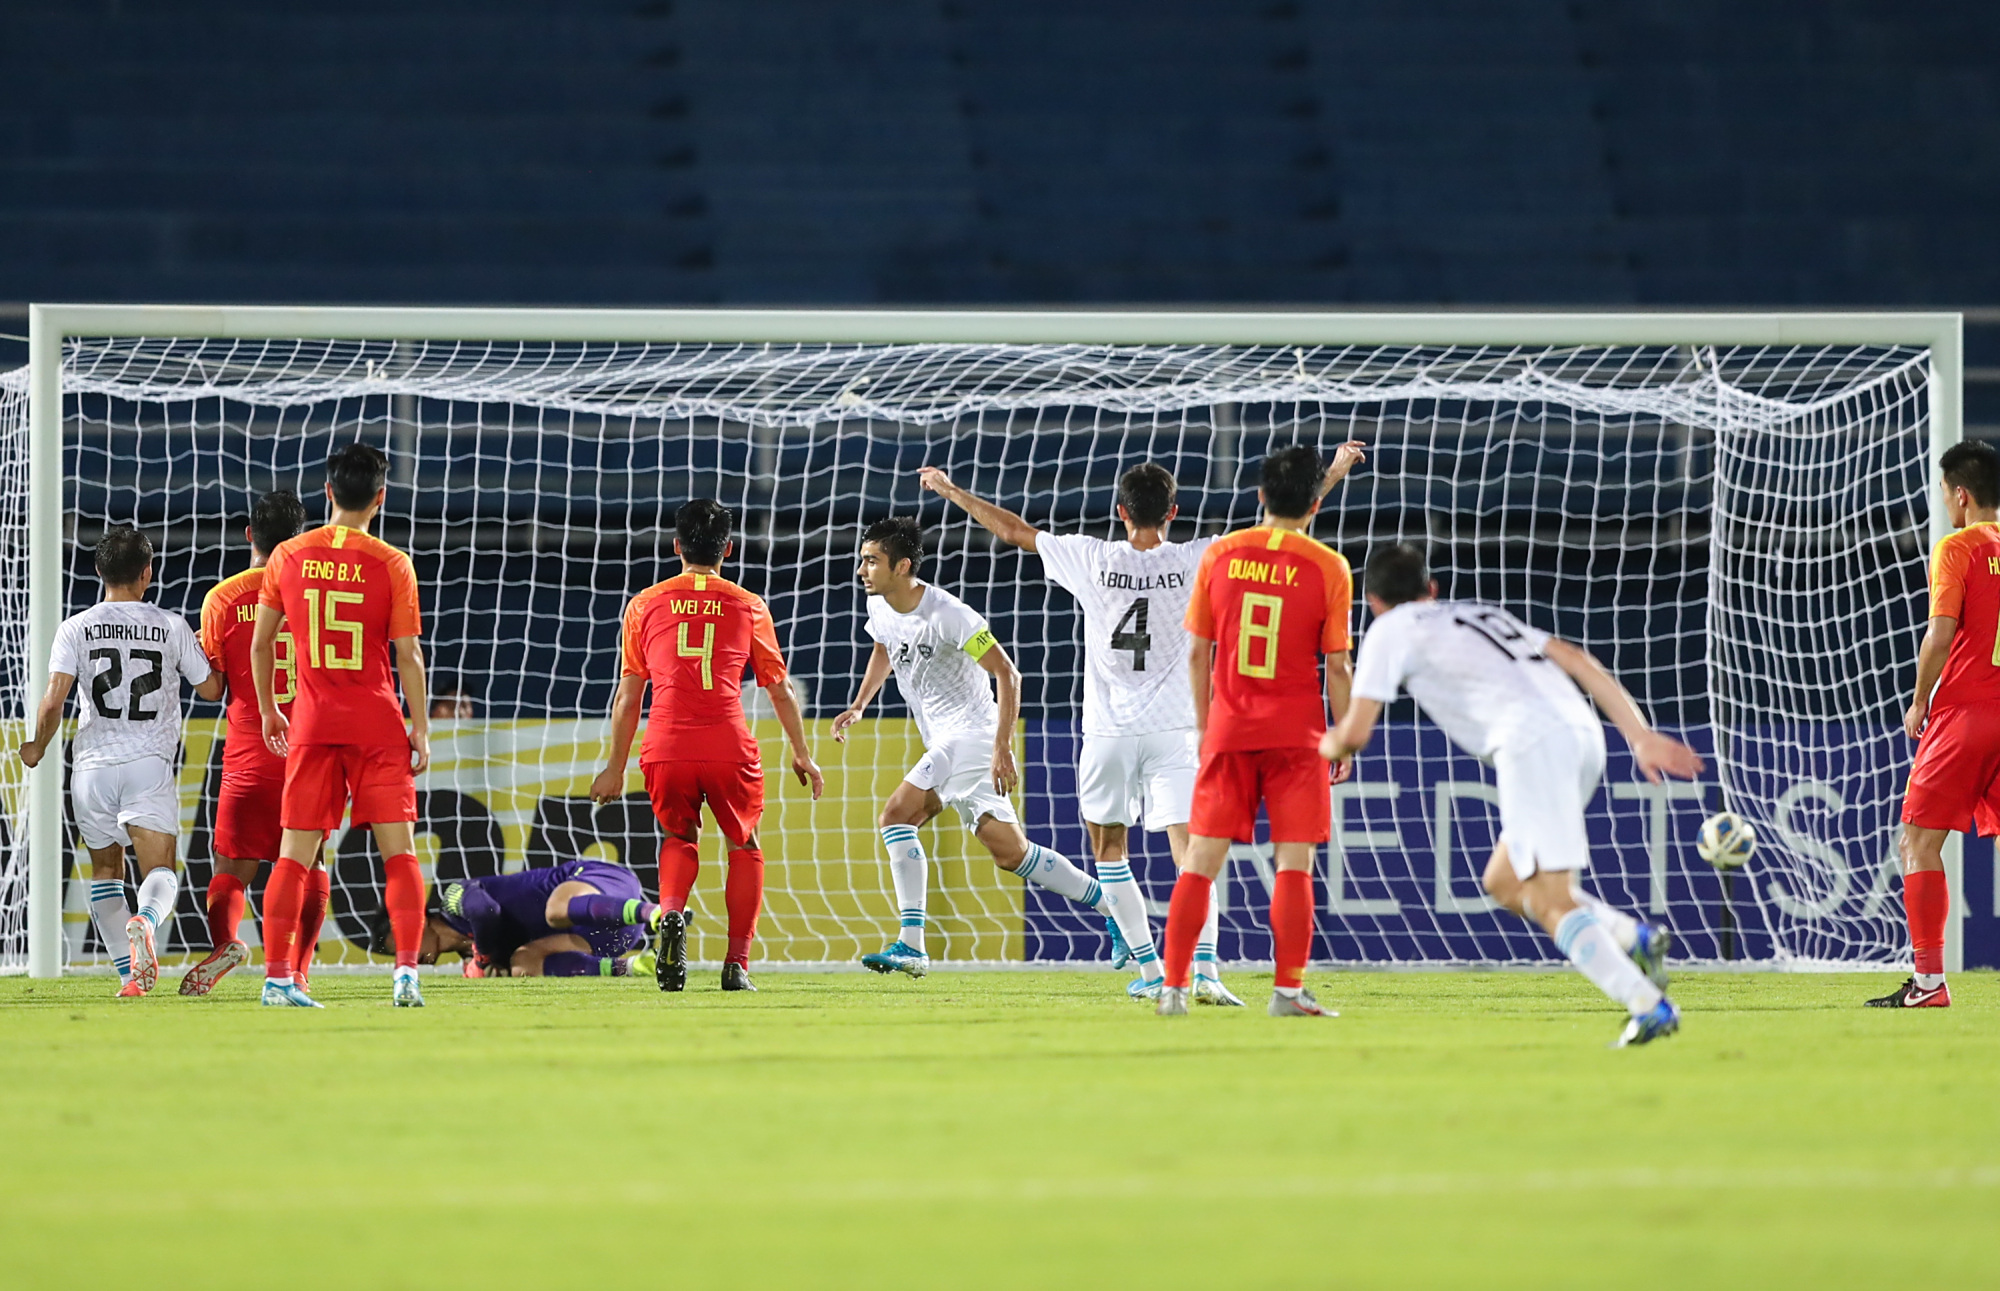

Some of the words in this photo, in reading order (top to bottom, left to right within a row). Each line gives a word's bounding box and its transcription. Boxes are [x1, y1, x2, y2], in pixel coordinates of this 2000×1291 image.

[302, 559, 334, 580] FENG
[1097, 570, 1185, 591] ABDULLAEV
[1228, 558, 1269, 583] DUAN
[304, 588, 364, 670] 15
[670, 599, 698, 614] WEI
[702, 600, 724, 616] ZH.
[84, 623, 170, 644] KODIRKULOV
[677, 622, 715, 690] 4
[1111, 597, 1151, 671] 4
[1238, 591, 1283, 680] 8
[89, 647, 163, 721] 22
